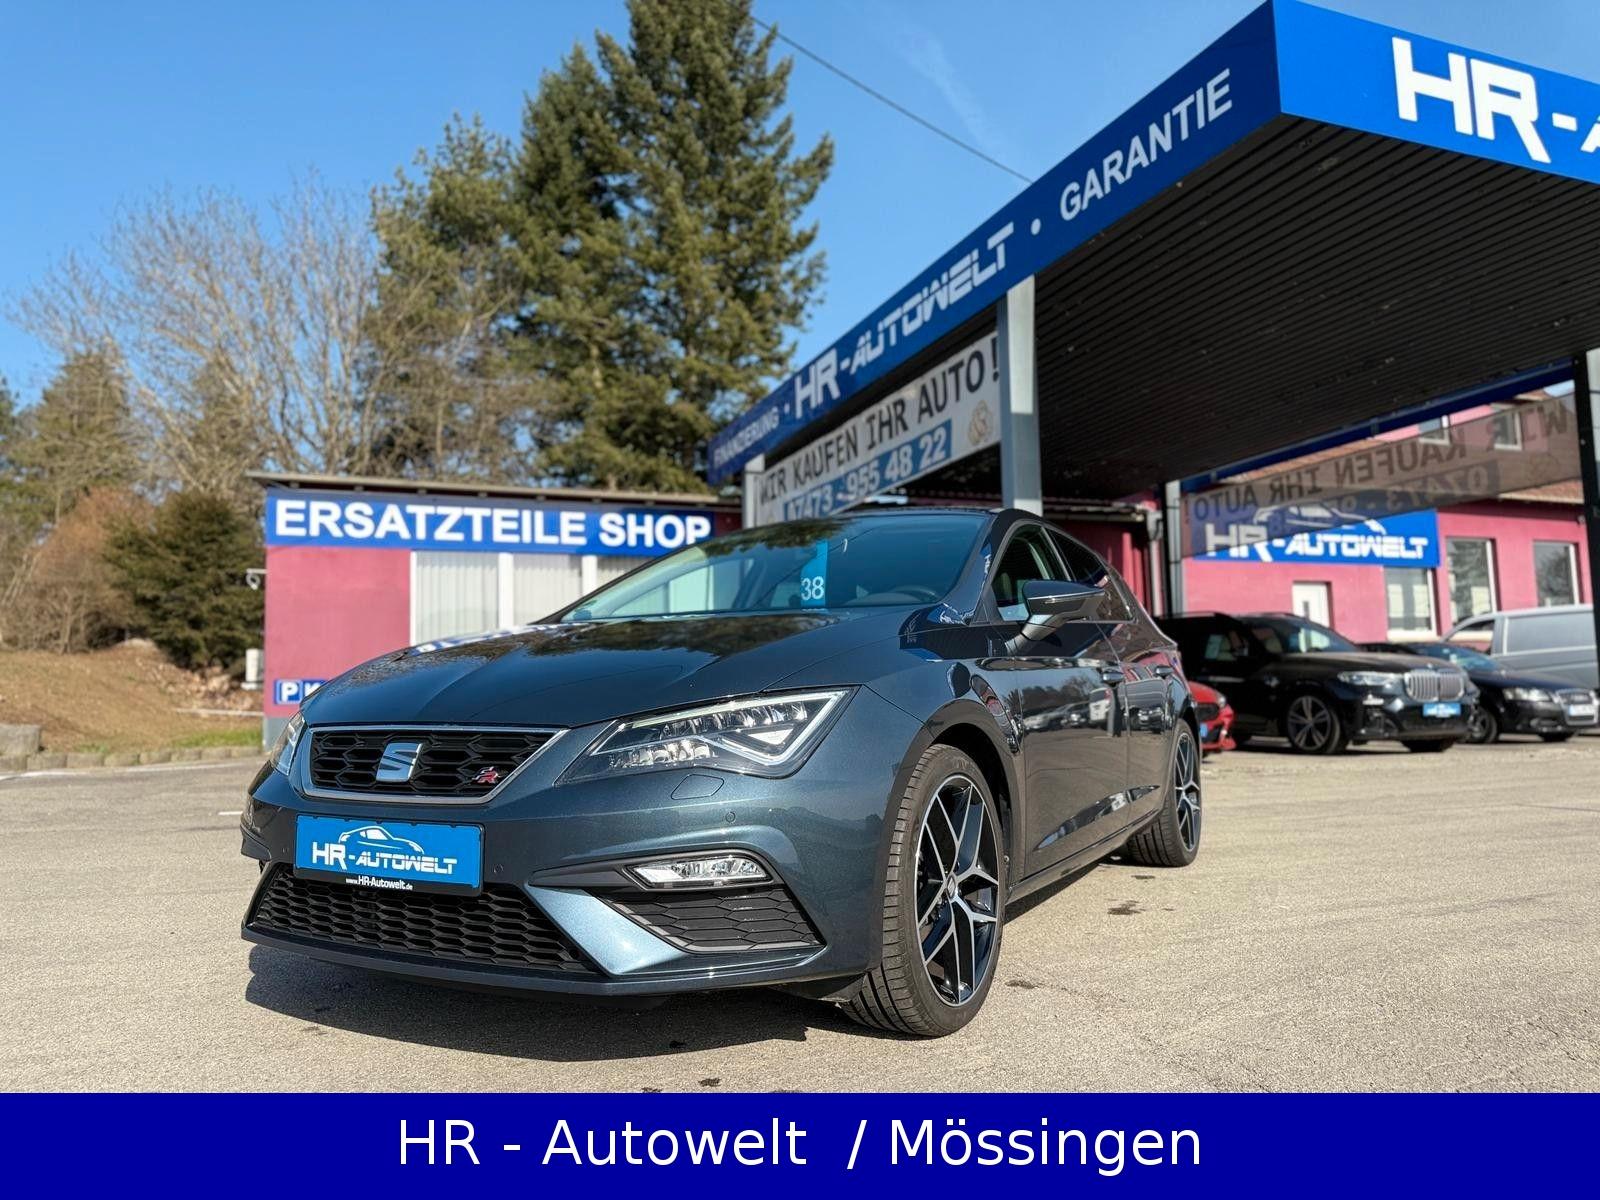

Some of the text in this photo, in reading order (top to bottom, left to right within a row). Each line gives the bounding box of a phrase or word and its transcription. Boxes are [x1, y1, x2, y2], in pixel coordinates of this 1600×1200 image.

[1059, 68, 1233, 221] GARANTIE
[760, 467, 787, 506] WIR
[793, 425, 858, 486] KAUFEN
[866, 399, 909, 450] IHR
[885, 444, 913, 482] 48
[920, 428, 947, 470] 22
[275, 499, 711, 548] ERSATZTEILE SHOP
[801, 575, 825, 601] 38
[312, 841, 458, 874] HR-AUTOWELT
